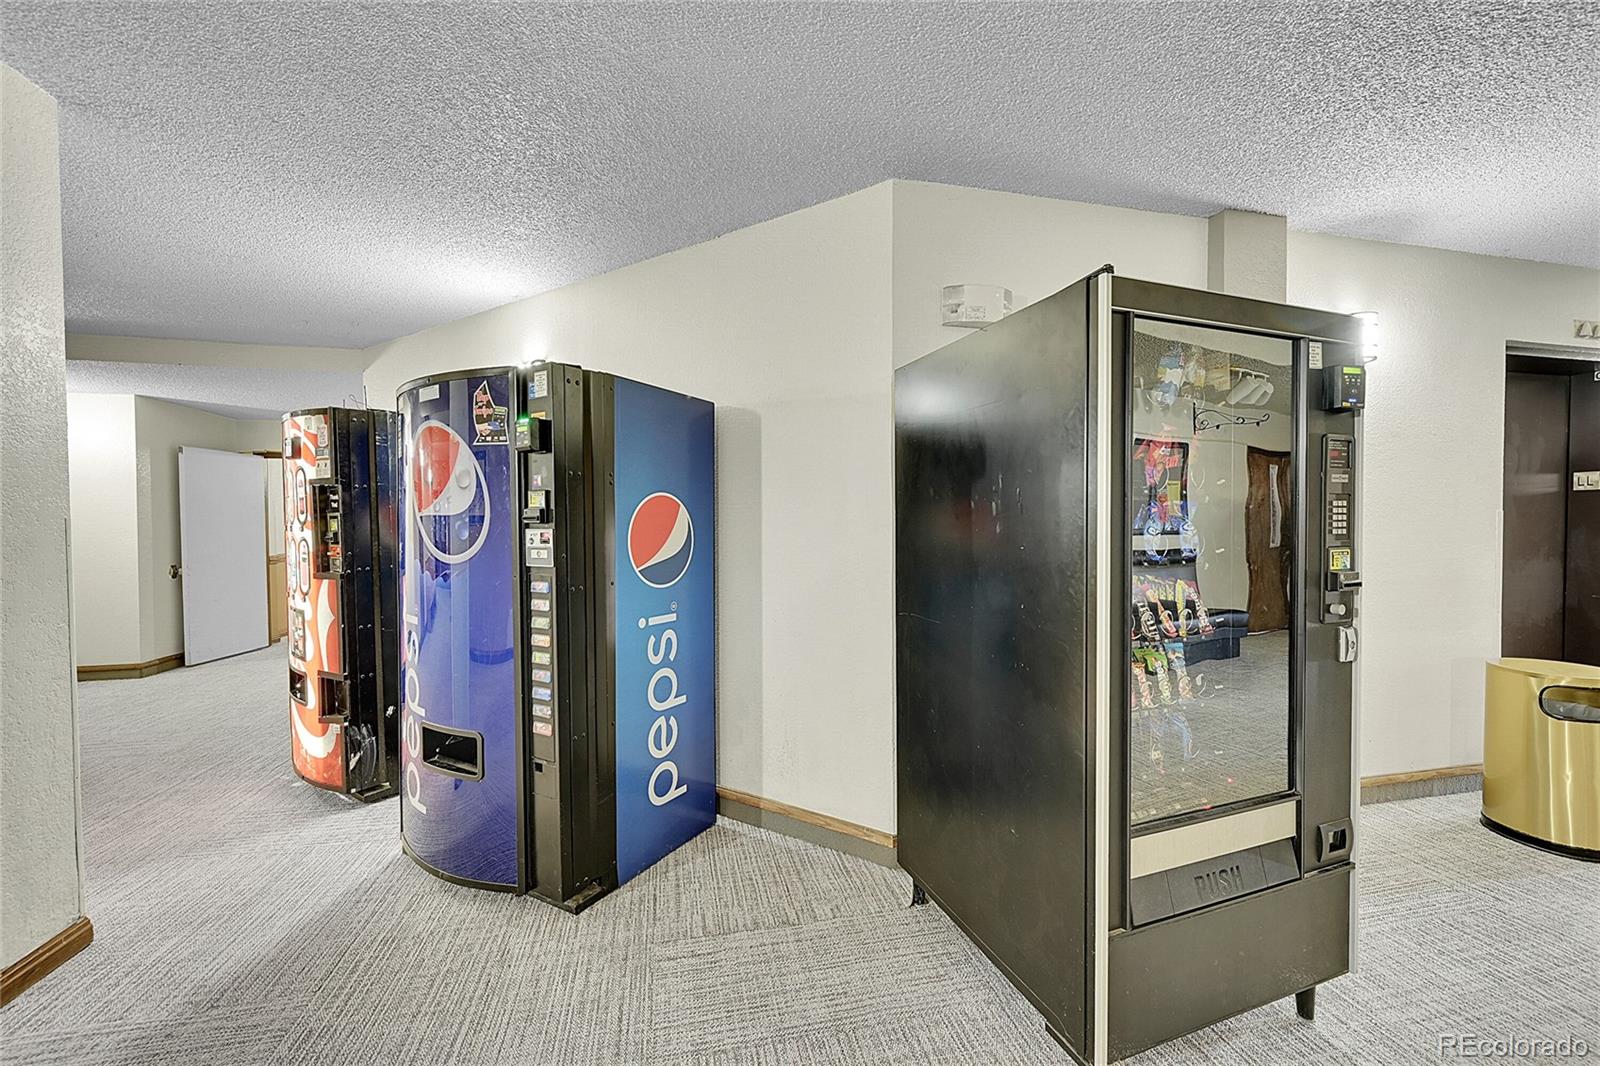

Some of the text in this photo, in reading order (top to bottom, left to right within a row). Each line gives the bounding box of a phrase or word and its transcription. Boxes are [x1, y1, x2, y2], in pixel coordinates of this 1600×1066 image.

[405, 612, 428, 815] pepsi
[637, 612, 688, 807] pepsi
[1194, 864, 1246, 902] PUSH
